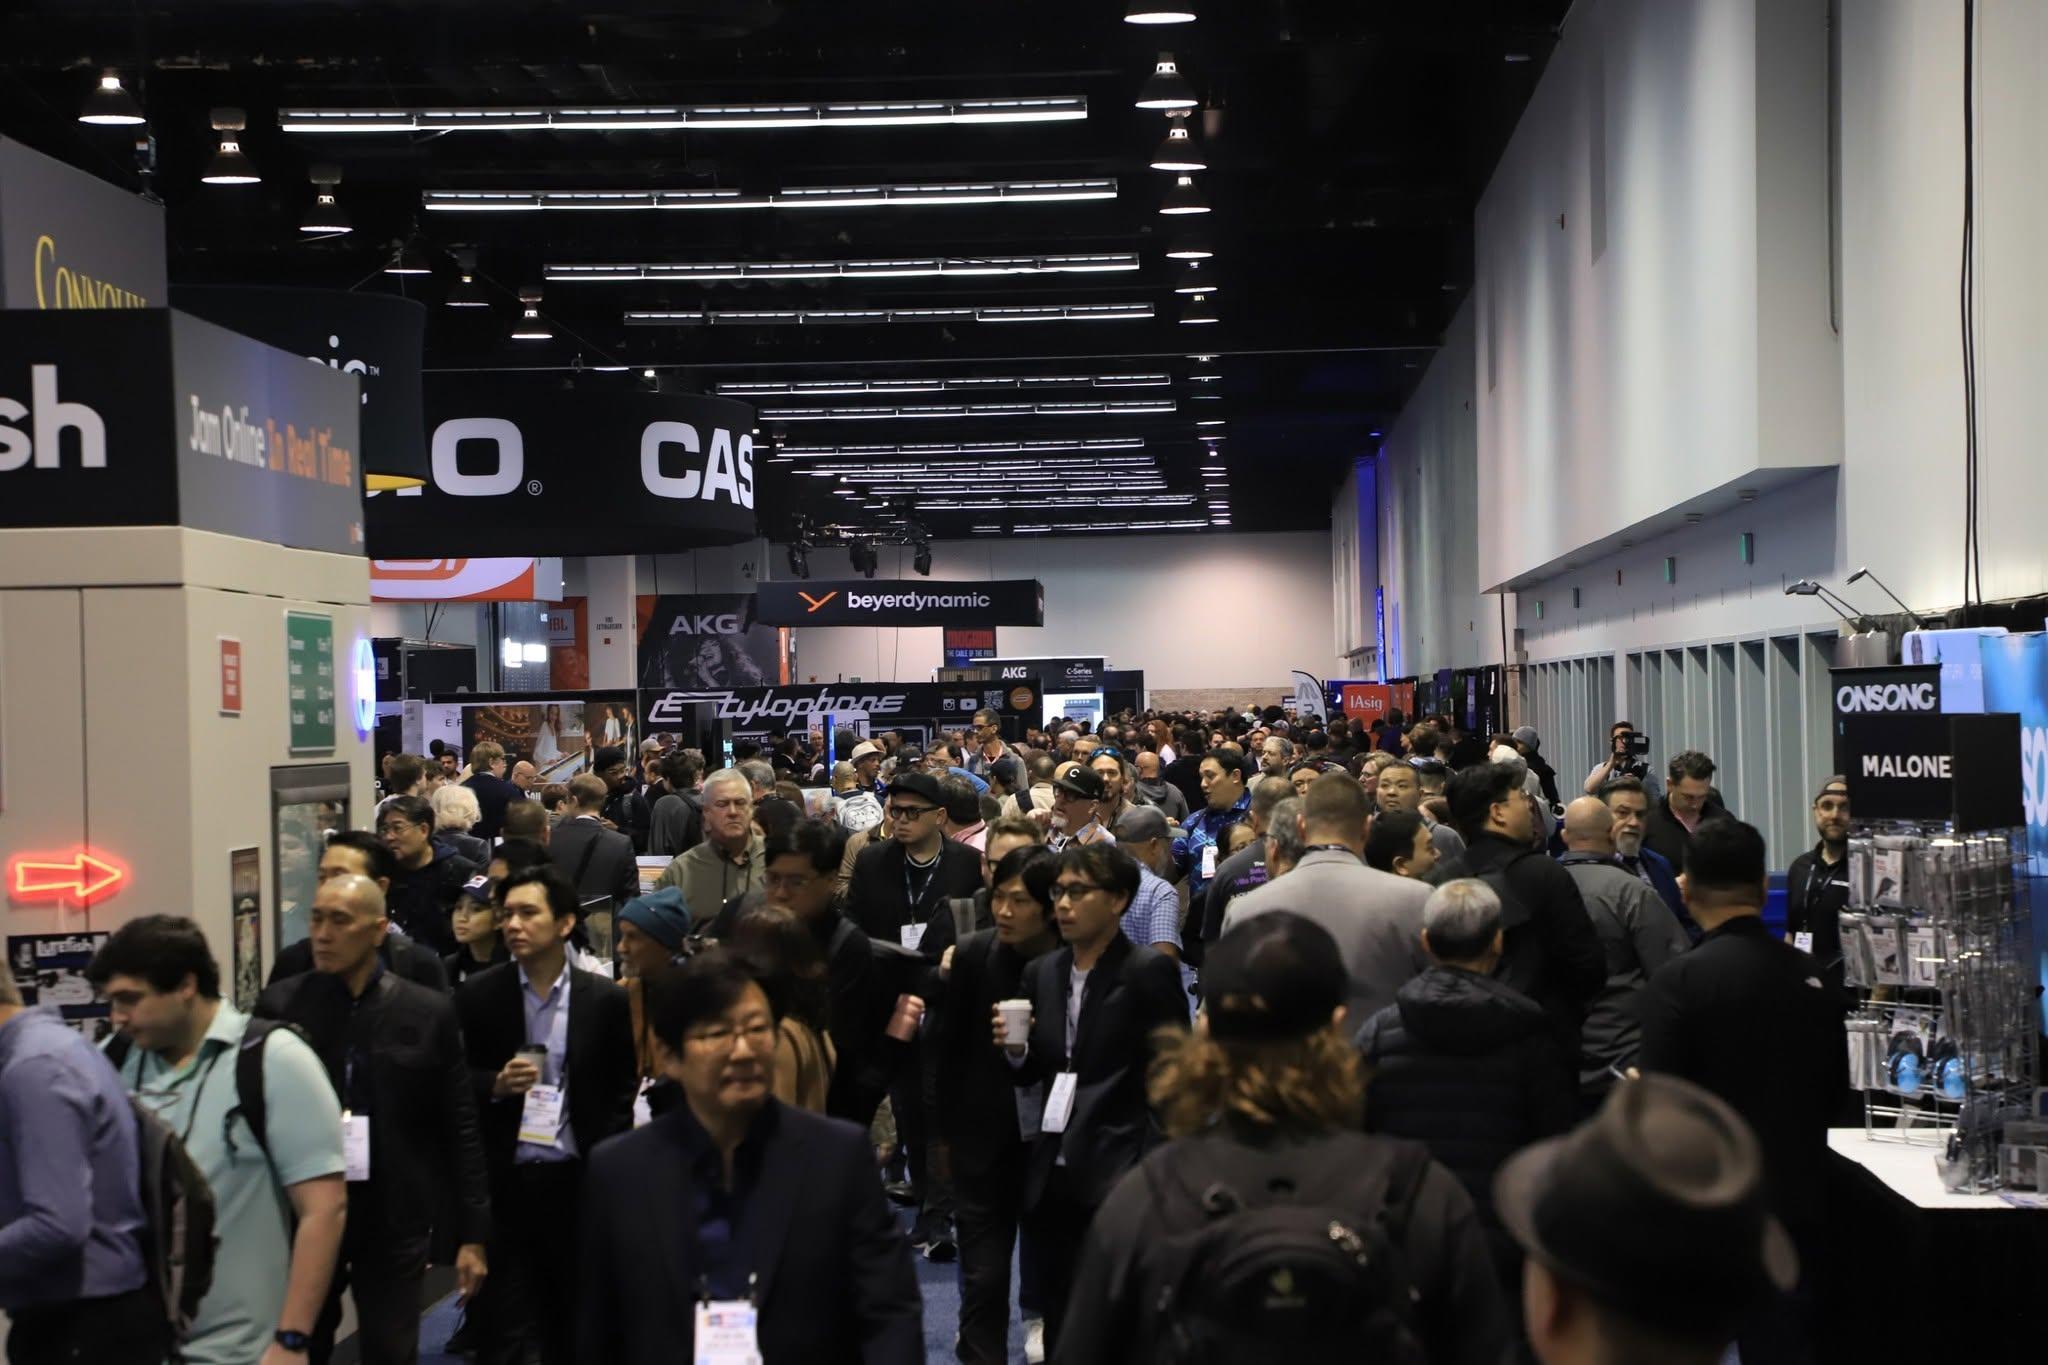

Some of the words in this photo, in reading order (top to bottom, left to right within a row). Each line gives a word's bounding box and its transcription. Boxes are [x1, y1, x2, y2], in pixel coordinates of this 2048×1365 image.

[640, 420, 754, 509] CAS
[847, 591, 991, 612] beyerdynamic
[669, 614, 739, 635] AKG
[1001, 666, 1028, 679] AKG
[1836, 682, 1937, 713] ONSONG
[1862, 755, 1953, 779] MALONE
